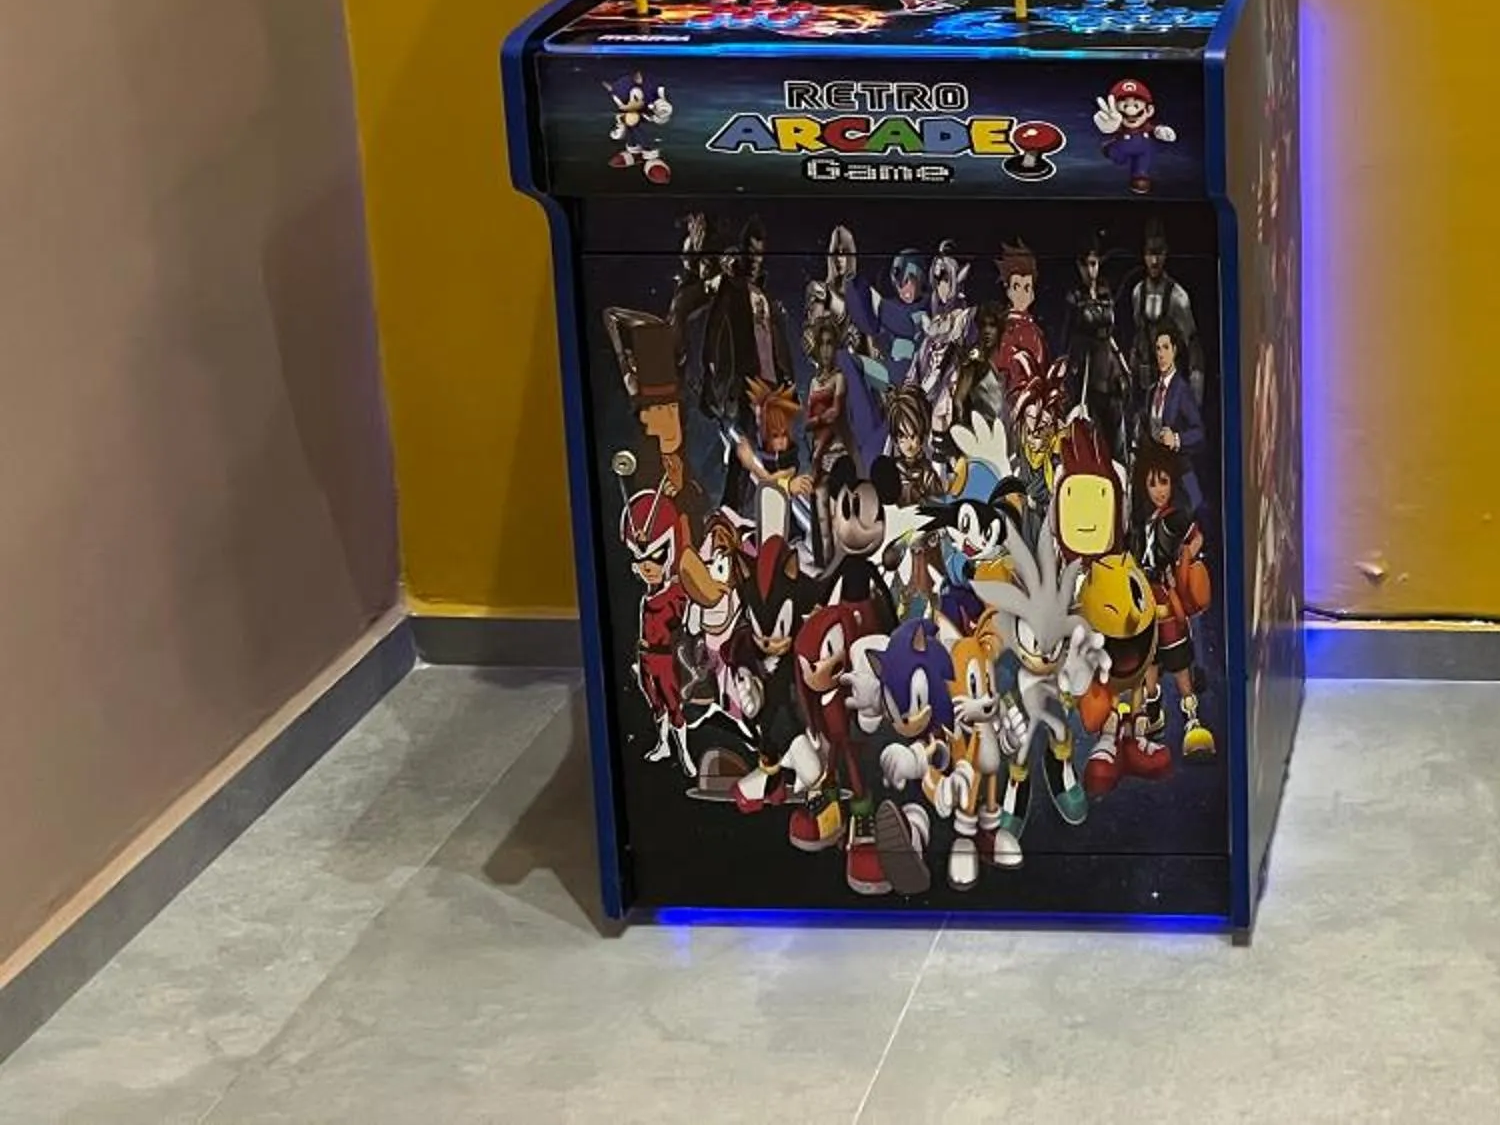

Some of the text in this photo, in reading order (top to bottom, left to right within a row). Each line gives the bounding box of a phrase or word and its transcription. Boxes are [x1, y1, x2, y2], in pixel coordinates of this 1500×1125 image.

[783, 80, 970, 113] RETRO
[705, 112, 1018, 158] ARCADE
[806, 158, 950, 183] Game
